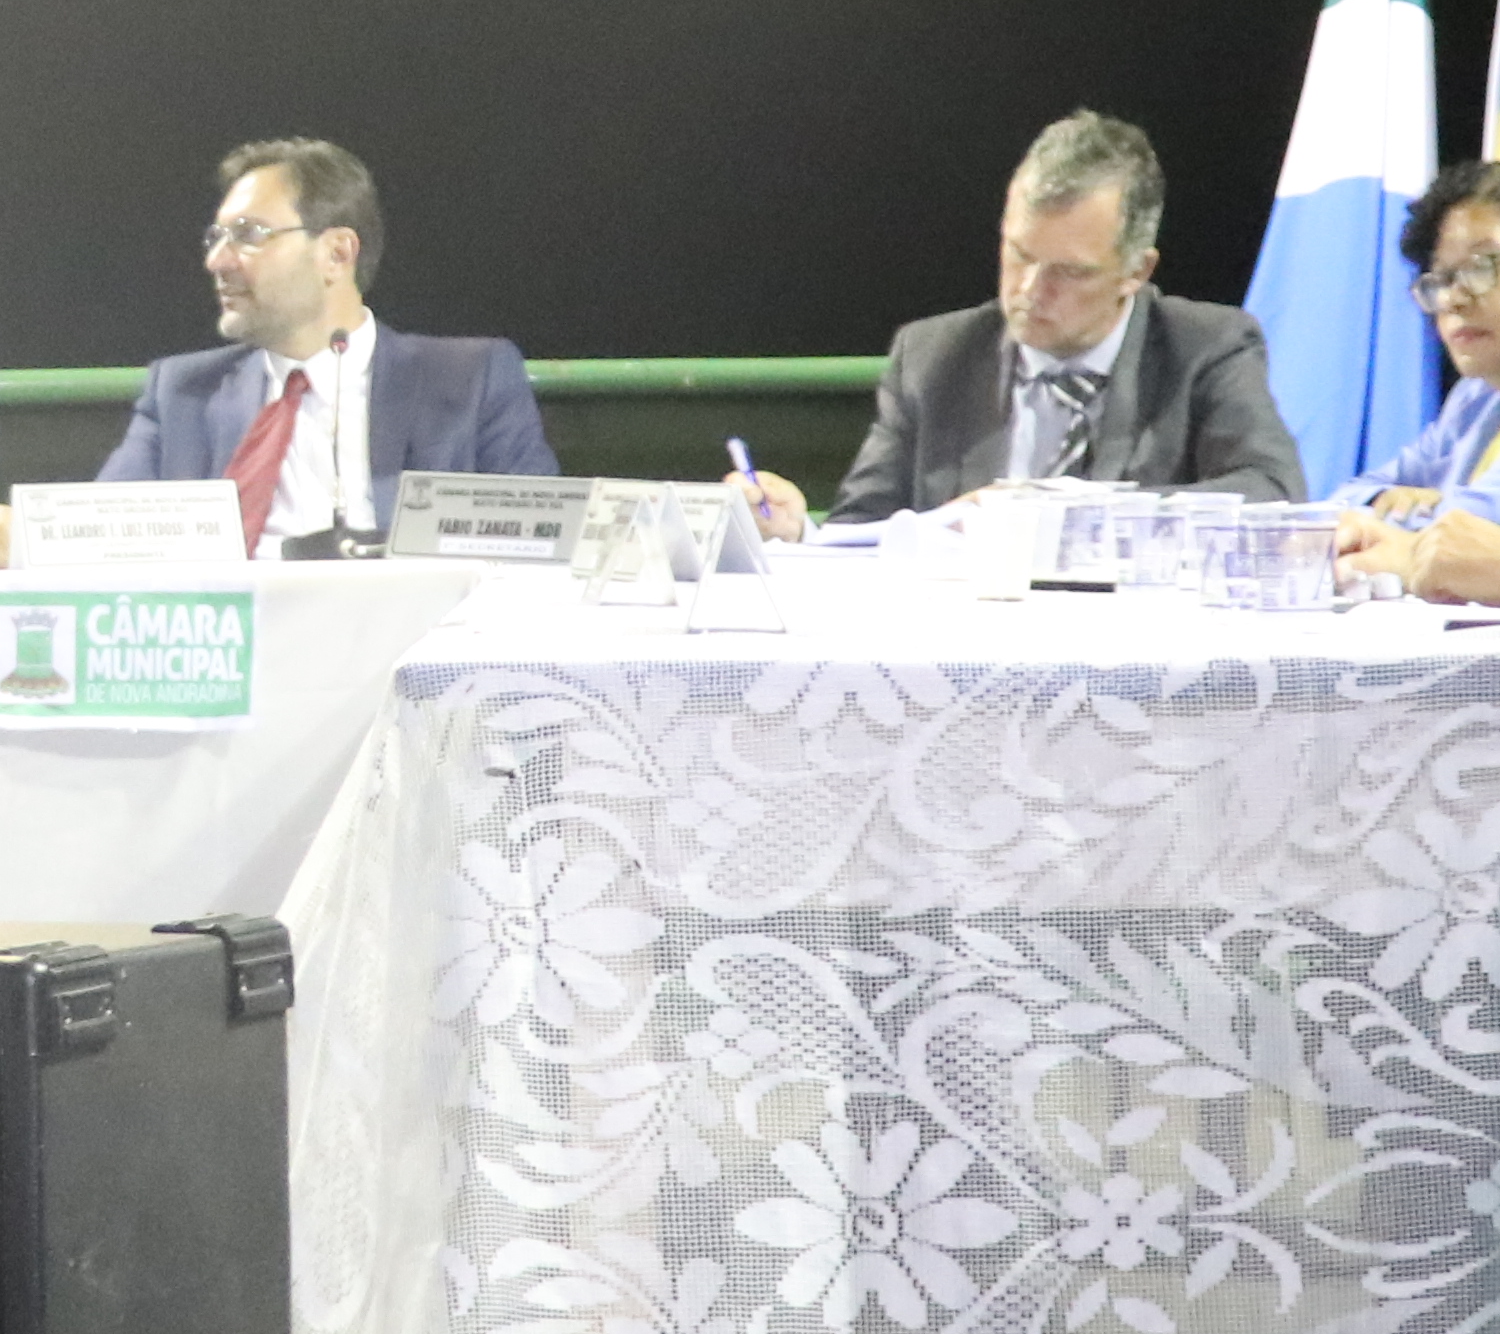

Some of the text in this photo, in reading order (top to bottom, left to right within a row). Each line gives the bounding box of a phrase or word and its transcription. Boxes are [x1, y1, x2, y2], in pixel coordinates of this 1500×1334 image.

[86, 594, 244, 645] CÂMARA
[87, 648, 244, 681] MUNICIPAL
[86, 683, 105, 703] DE
